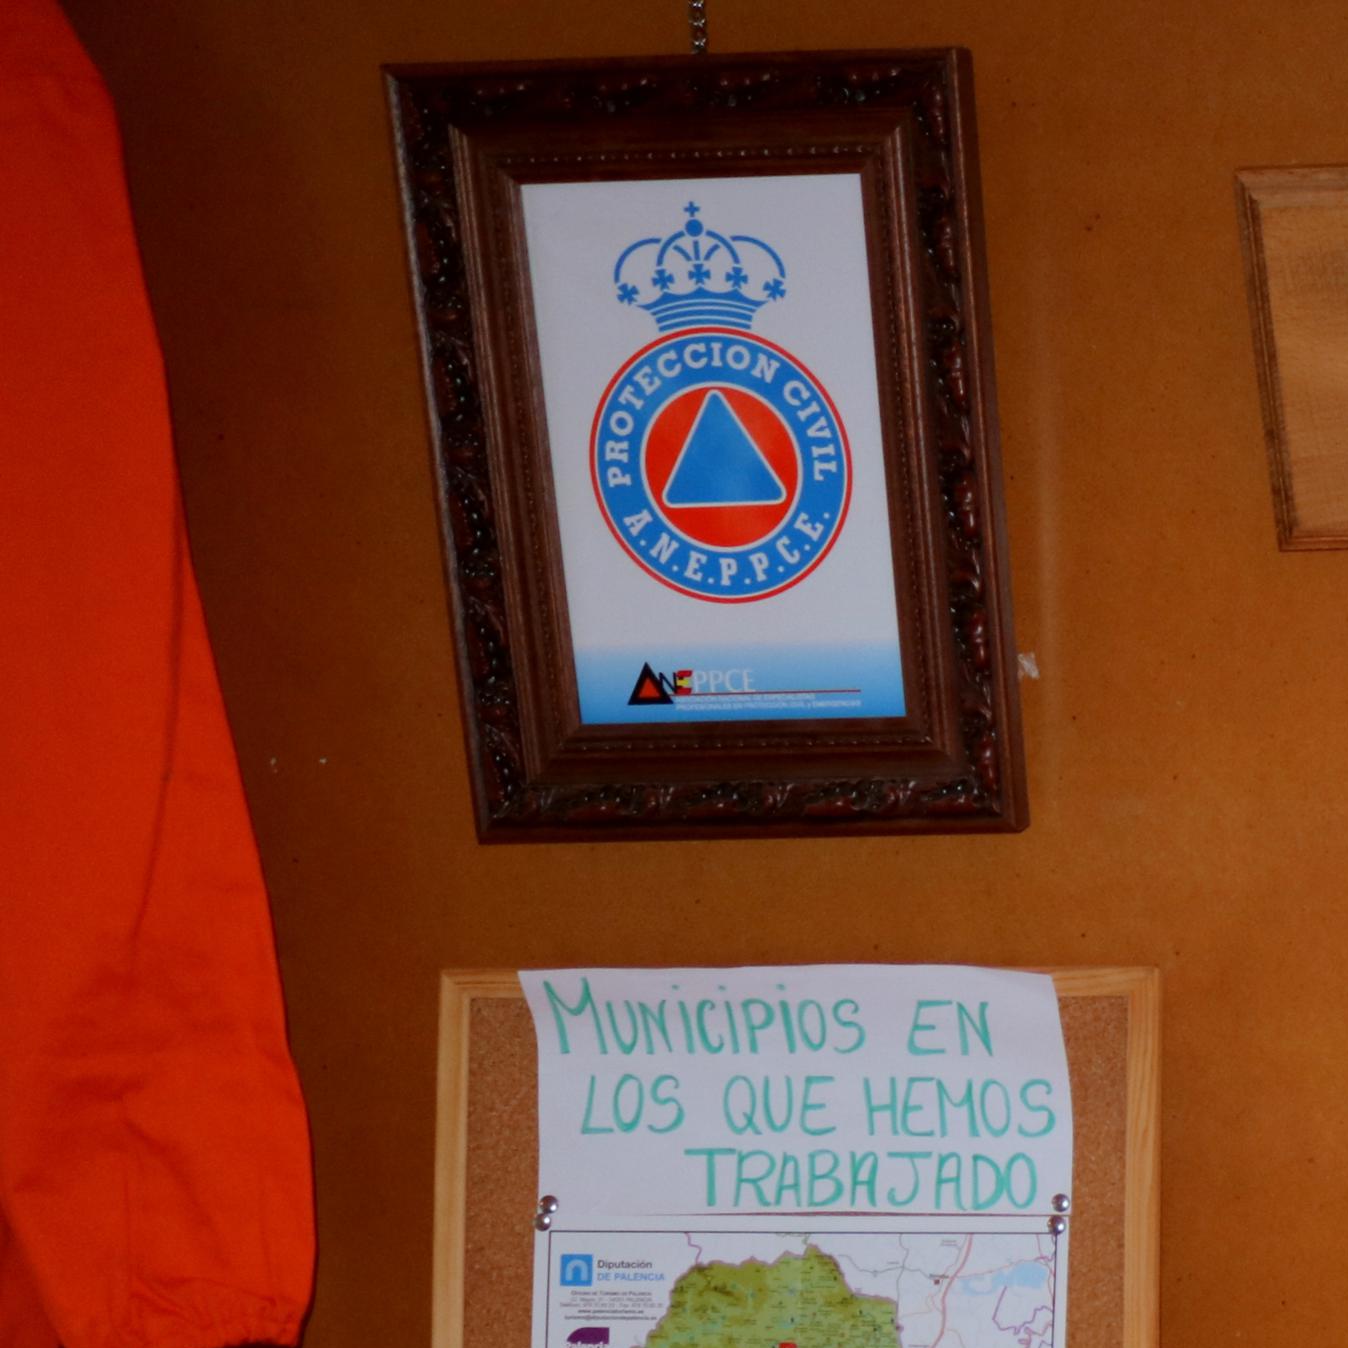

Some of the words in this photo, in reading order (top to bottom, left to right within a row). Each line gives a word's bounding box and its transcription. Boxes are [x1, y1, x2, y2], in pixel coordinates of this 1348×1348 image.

[605, 342, 780, 488] PROTECCION
[783, 380, 837, 481] CIVIL
[623, 509, 830, 587] A.N.E.P.P.C.E.
[907, 1000, 994, 1056] EN
[580, 1073, 685, 1135] LOS
[723, 1075, 837, 1136] QUE
[863, 1076, 1056, 1138] HEMOS
[684, 1147, 1038, 1210] TRABAJADO
[597, 1260, 652, 1269] Diputación
